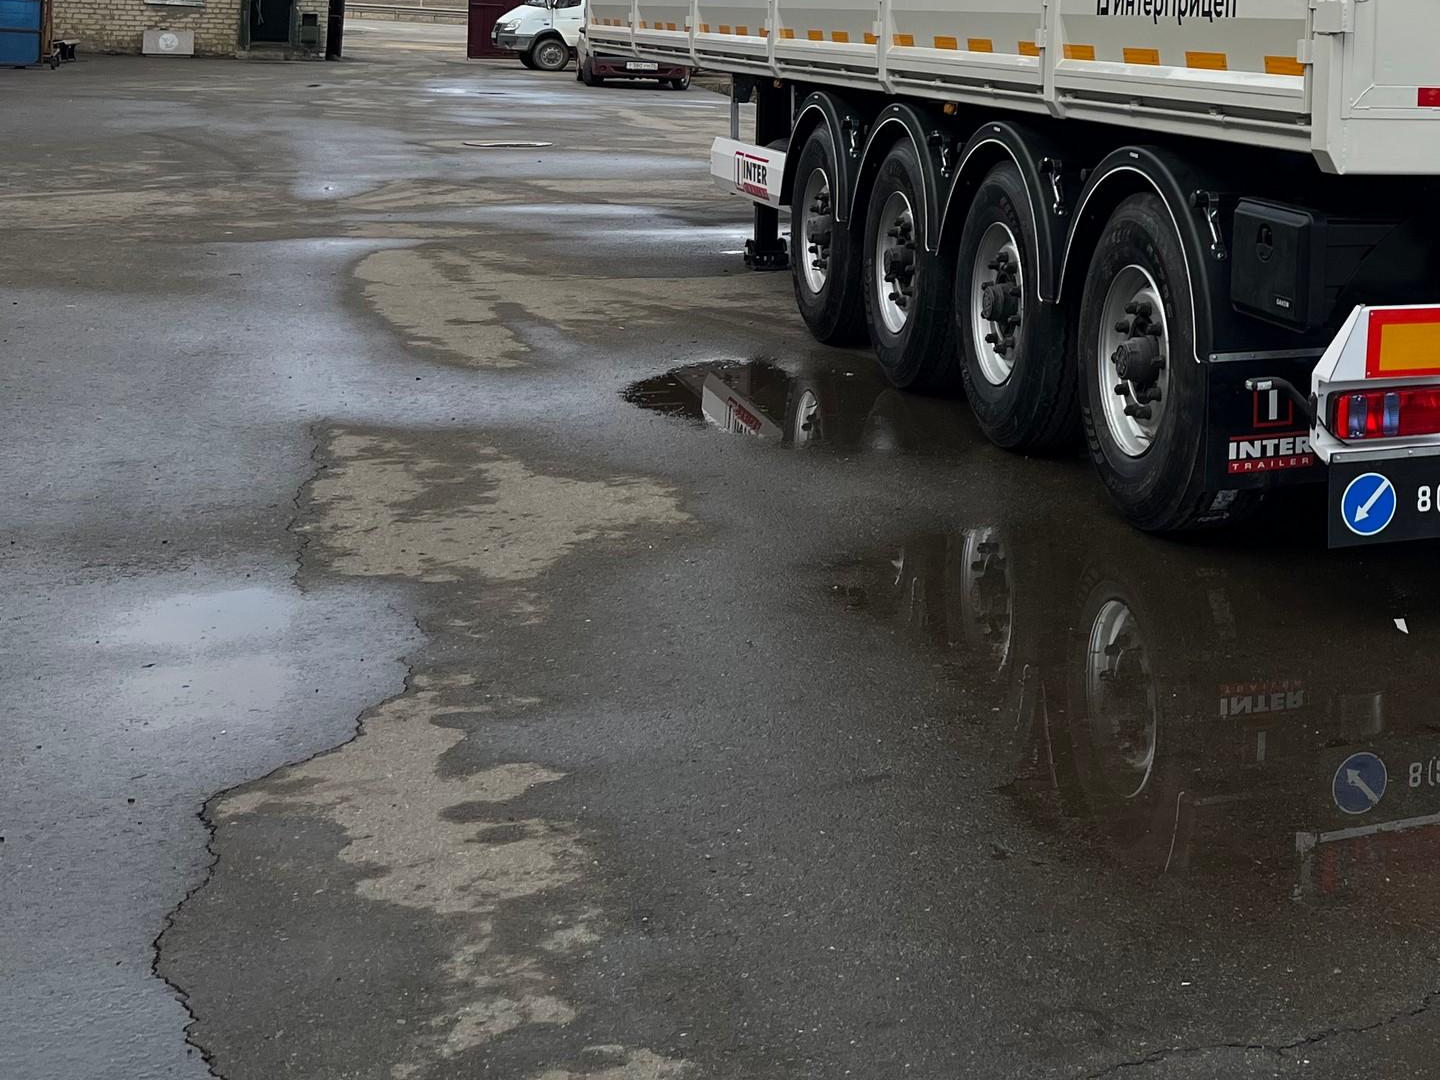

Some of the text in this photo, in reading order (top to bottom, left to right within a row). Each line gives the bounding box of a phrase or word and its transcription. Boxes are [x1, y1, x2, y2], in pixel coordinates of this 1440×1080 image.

[743, 160, 767, 185] INTER
[1228, 436, 1313, 460] INTER
[1231, 457, 1309, 471] TRAILER
[1417, 485, 1431, 512] 8
